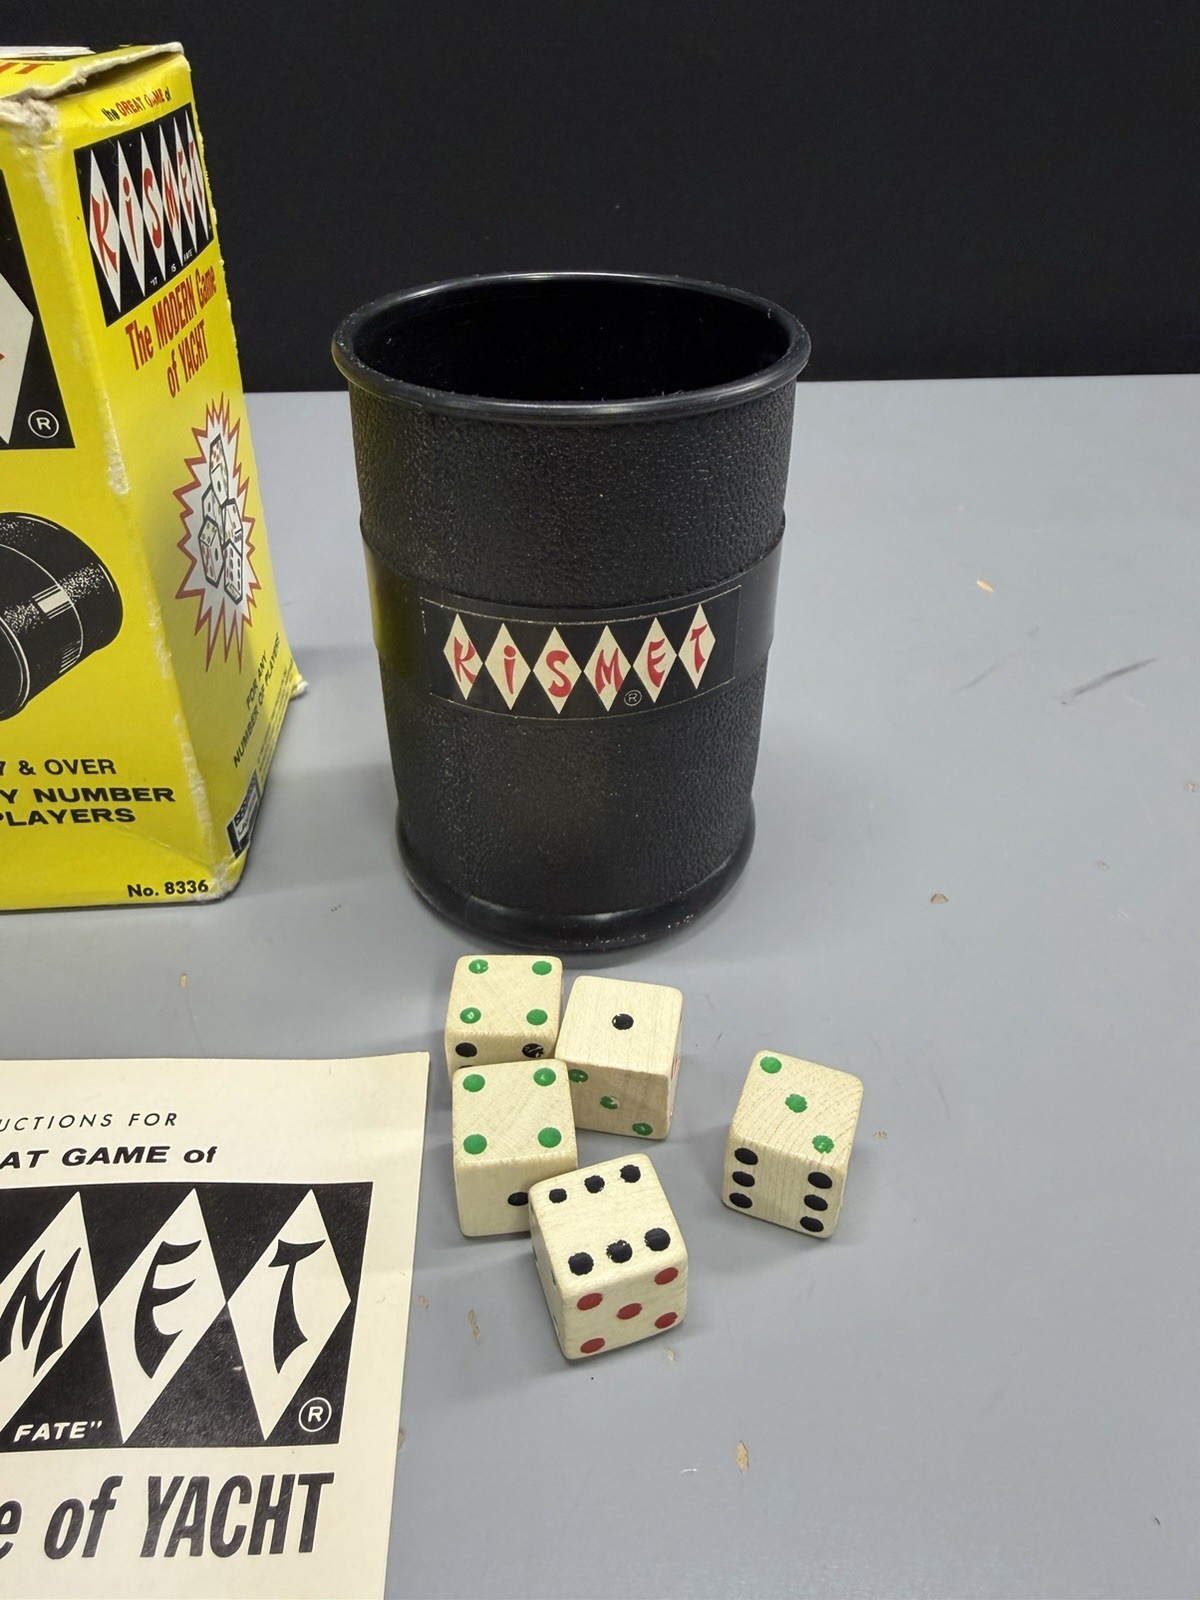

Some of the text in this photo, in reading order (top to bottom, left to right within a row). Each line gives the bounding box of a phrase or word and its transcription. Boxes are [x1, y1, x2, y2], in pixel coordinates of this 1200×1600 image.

[115, 97, 146, 117] GREAT
[125, 266, 216, 371] The MODERN Game
[167, 319, 208, 398] of YACHT
[246, 650, 267, 710] FOR ANY
[233, 704, 259, 768] NUMBER
[258, 684, 265, 706] OF
[19, 760, 37, 776] &
[44, 759, 117, 776] OVER
[33, 787, 176, 803] NUMBER
[0, 808, 136, 826] LAYERS
[127, 880, 209, 898] No. 8336
[128, 1113, 177, 1127] FOR
[0, 1146, 218, 1170] AT GAME of
[44, 1475, 123, 1560] of
[139, 1472, 335, 1558] YACHT
